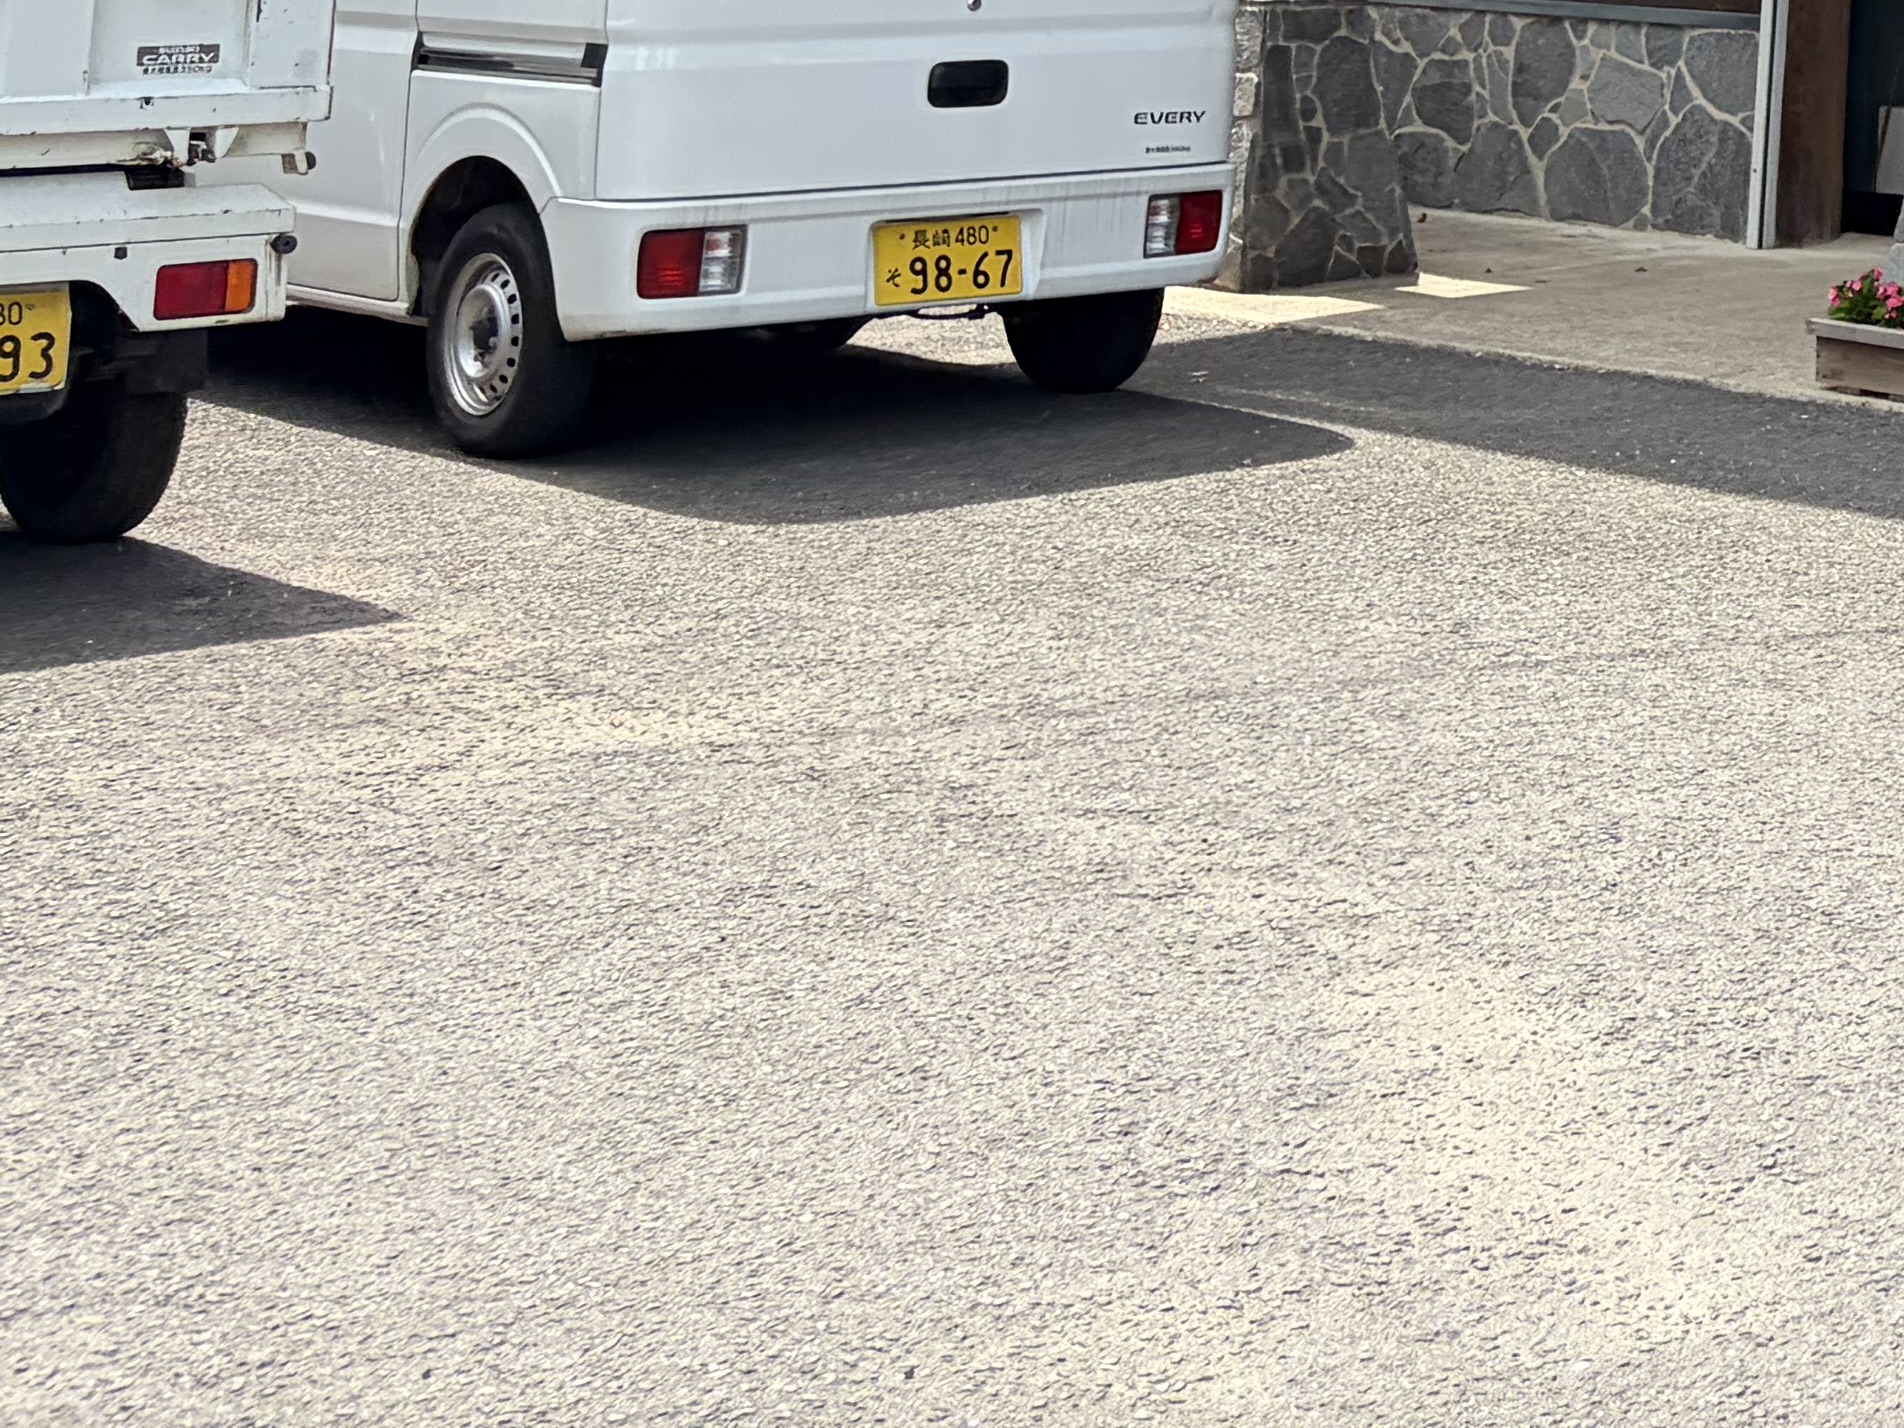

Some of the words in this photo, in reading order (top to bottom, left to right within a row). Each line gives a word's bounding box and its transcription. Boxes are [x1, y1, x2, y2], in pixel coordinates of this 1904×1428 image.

[142, 52, 215, 64] CARRY
[1133, 110, 1207, 125] EVERY
[954, 224, 990, 246] 480
[885, 267, 902, 288] そ
[908, 248, 1014, 296] 98-67
